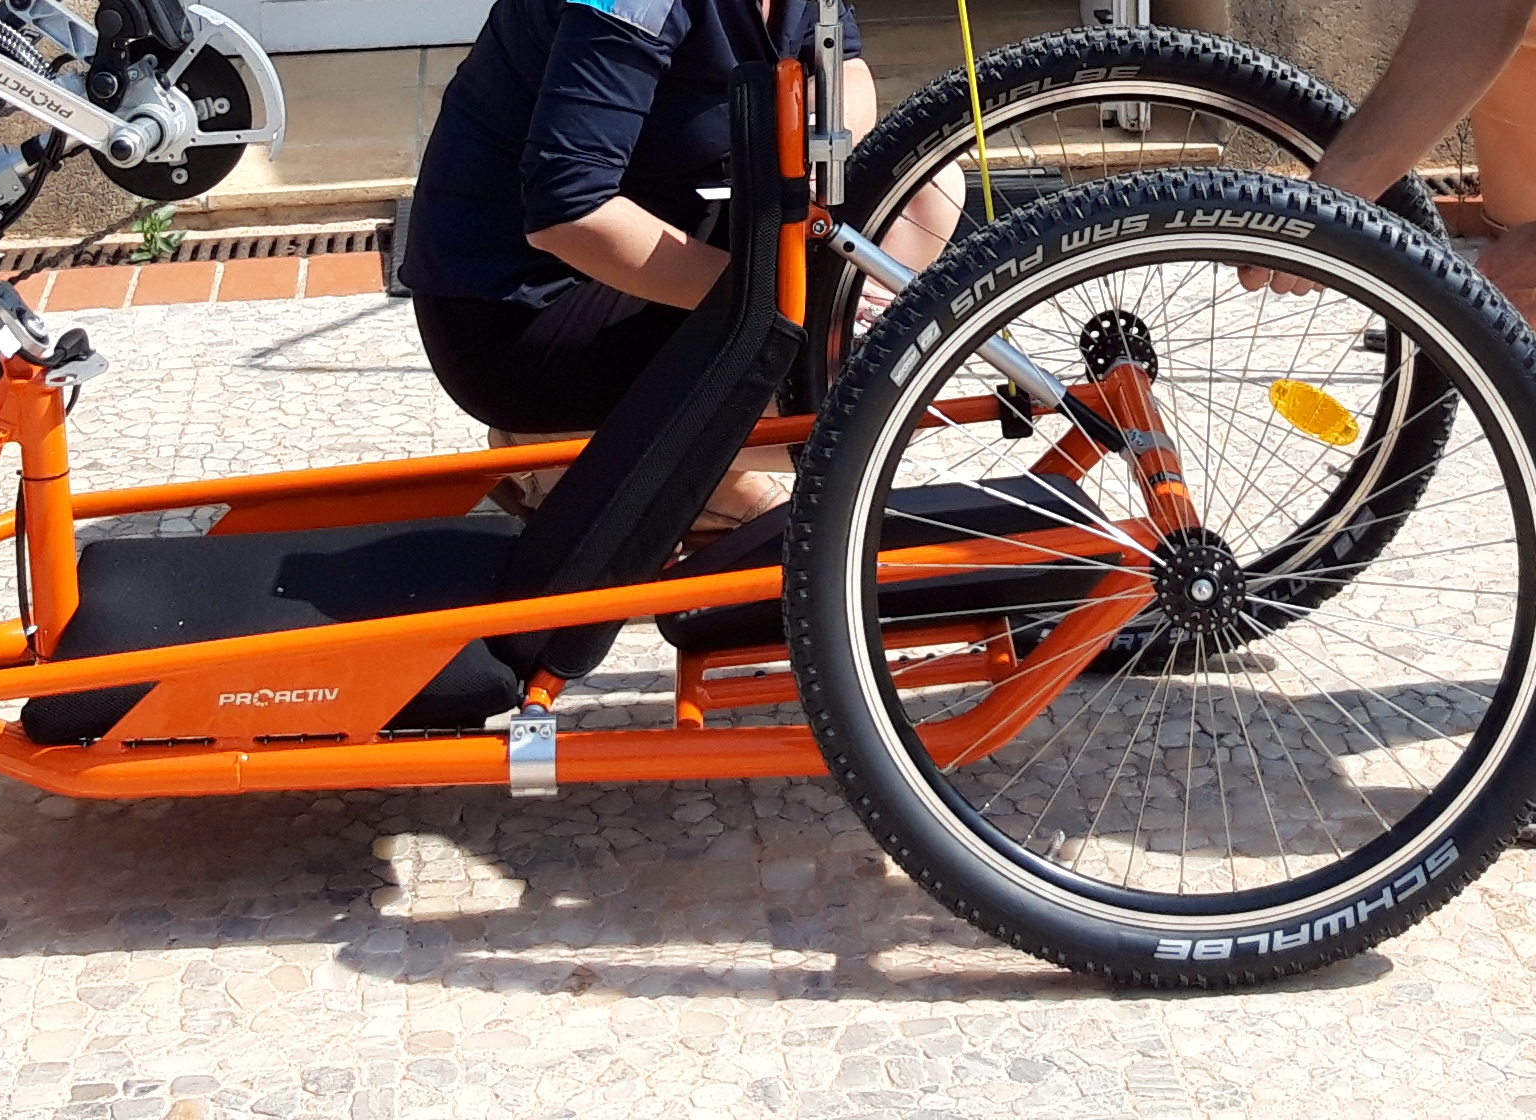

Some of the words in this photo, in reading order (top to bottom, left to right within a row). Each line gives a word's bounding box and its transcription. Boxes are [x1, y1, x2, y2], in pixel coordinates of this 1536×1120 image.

[891, 65, 1141, 178] SCHWALBE
[1060, 213, 1150, 254] SAM
[1164, 209, 1316, 240] SMART
[949, 243, 1044, 321] PLUS
[218, 688, 339, 707] PROACTIV
[1153, 837, 1460, 961] SCHWALBE
